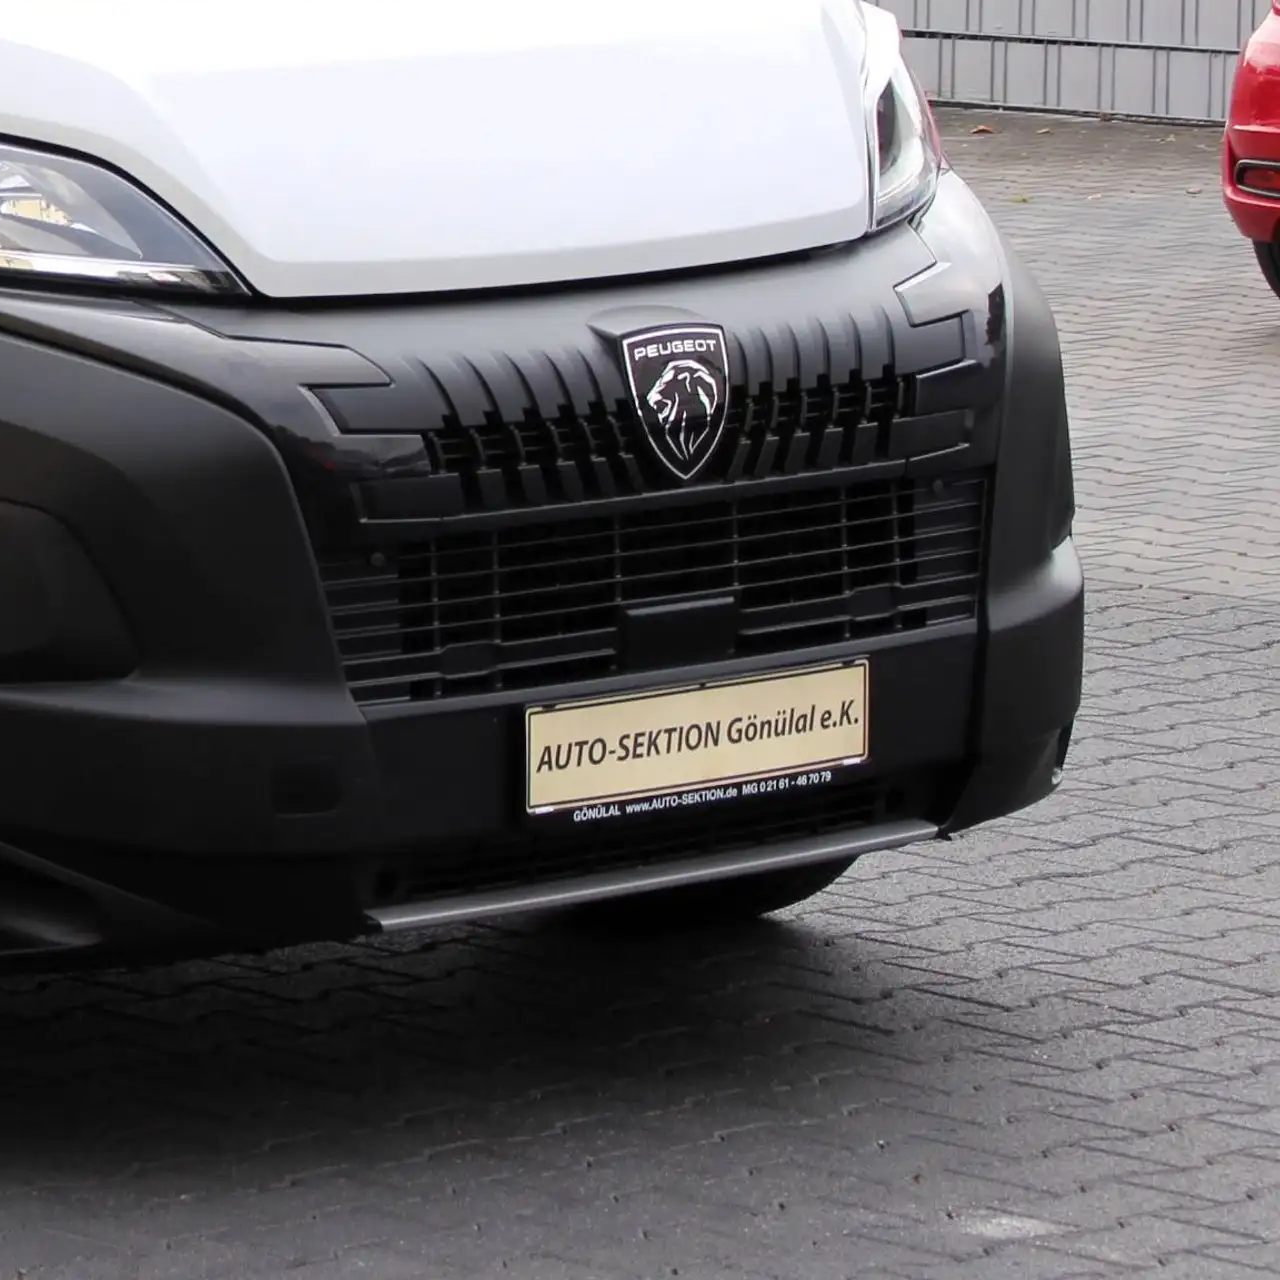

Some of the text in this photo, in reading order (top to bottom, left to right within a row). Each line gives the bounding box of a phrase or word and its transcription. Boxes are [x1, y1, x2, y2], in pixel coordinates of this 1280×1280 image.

[633, 339, 717, 361] PEUGEOT
[536, 699, 860, 773] AUTO-SEKTION Gönülal e.K.
[573, 804, 621, 821] GÖNÜLAL
[625, 787, 738, 814] www.AUTO-SEKTION.de
[742, 783, 758, 796] MG
